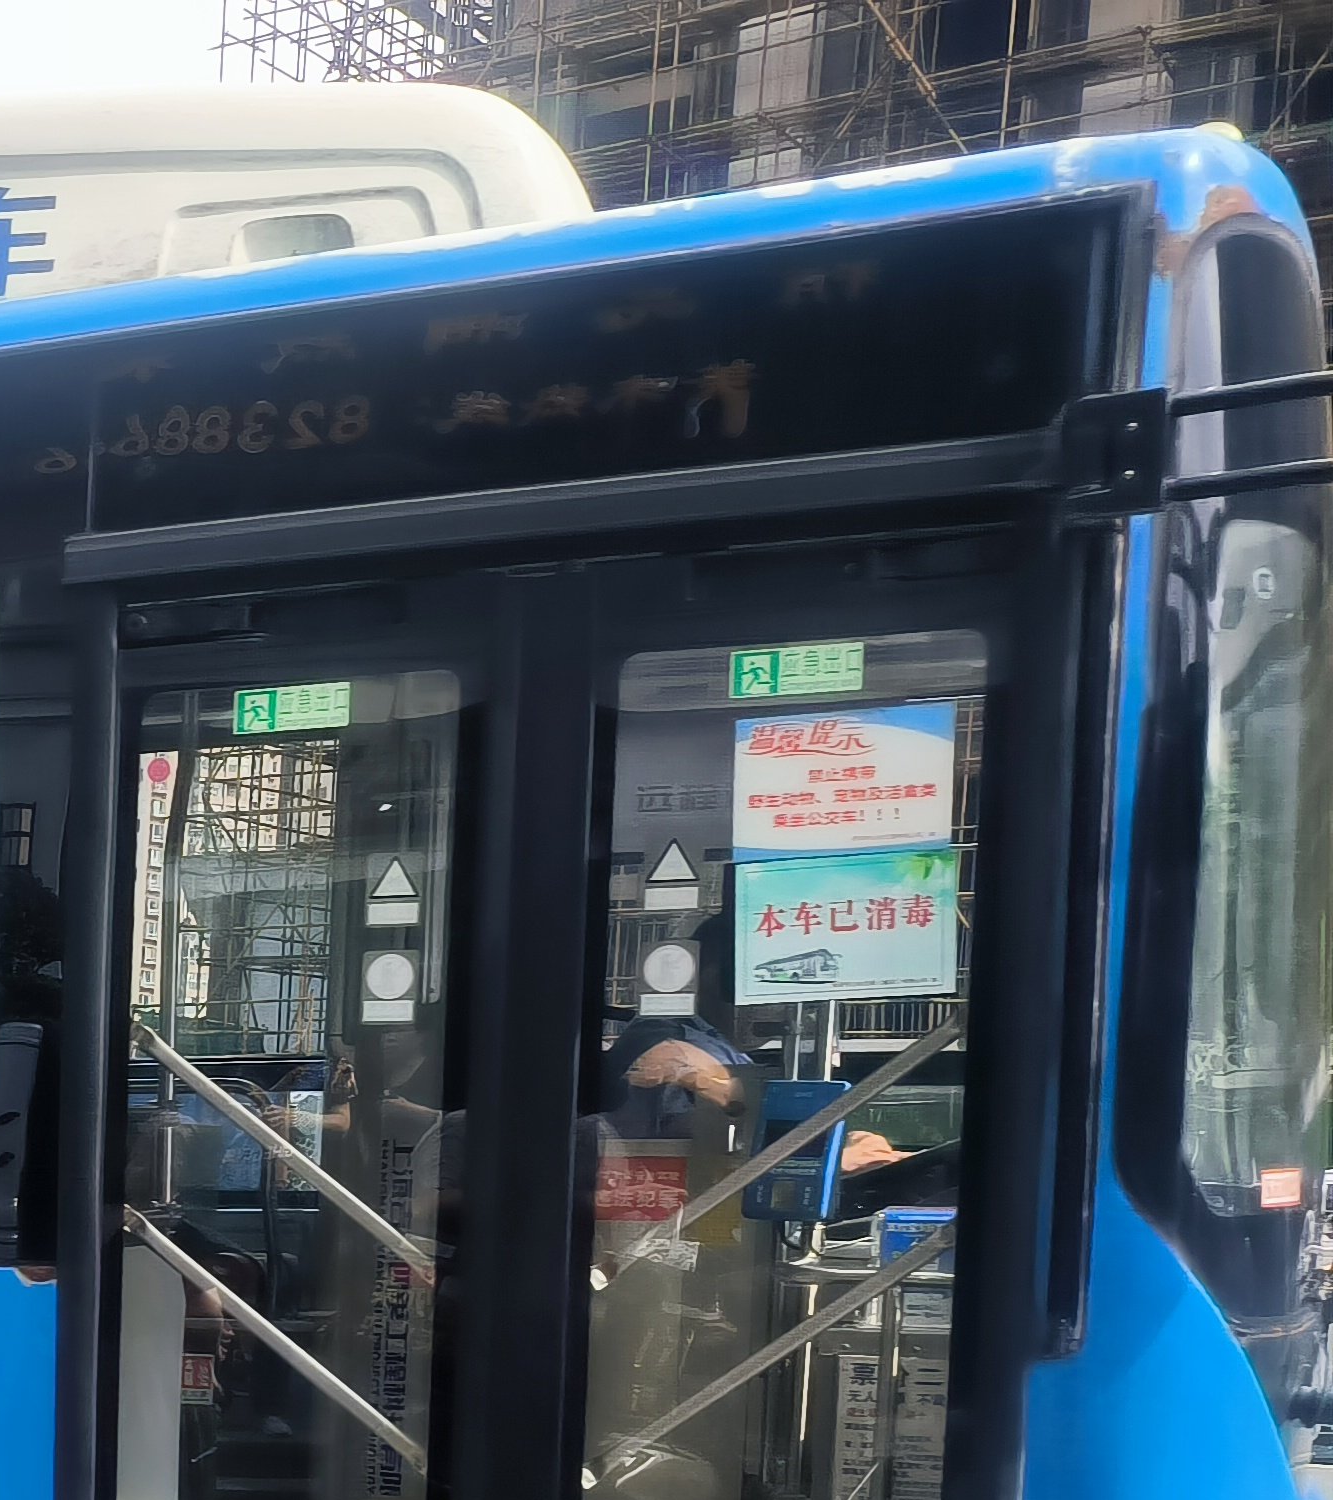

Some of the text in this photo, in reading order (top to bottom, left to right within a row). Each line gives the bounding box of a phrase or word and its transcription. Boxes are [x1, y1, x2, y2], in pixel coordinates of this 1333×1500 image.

[754, 894, 936, 937] 本车已消毒
